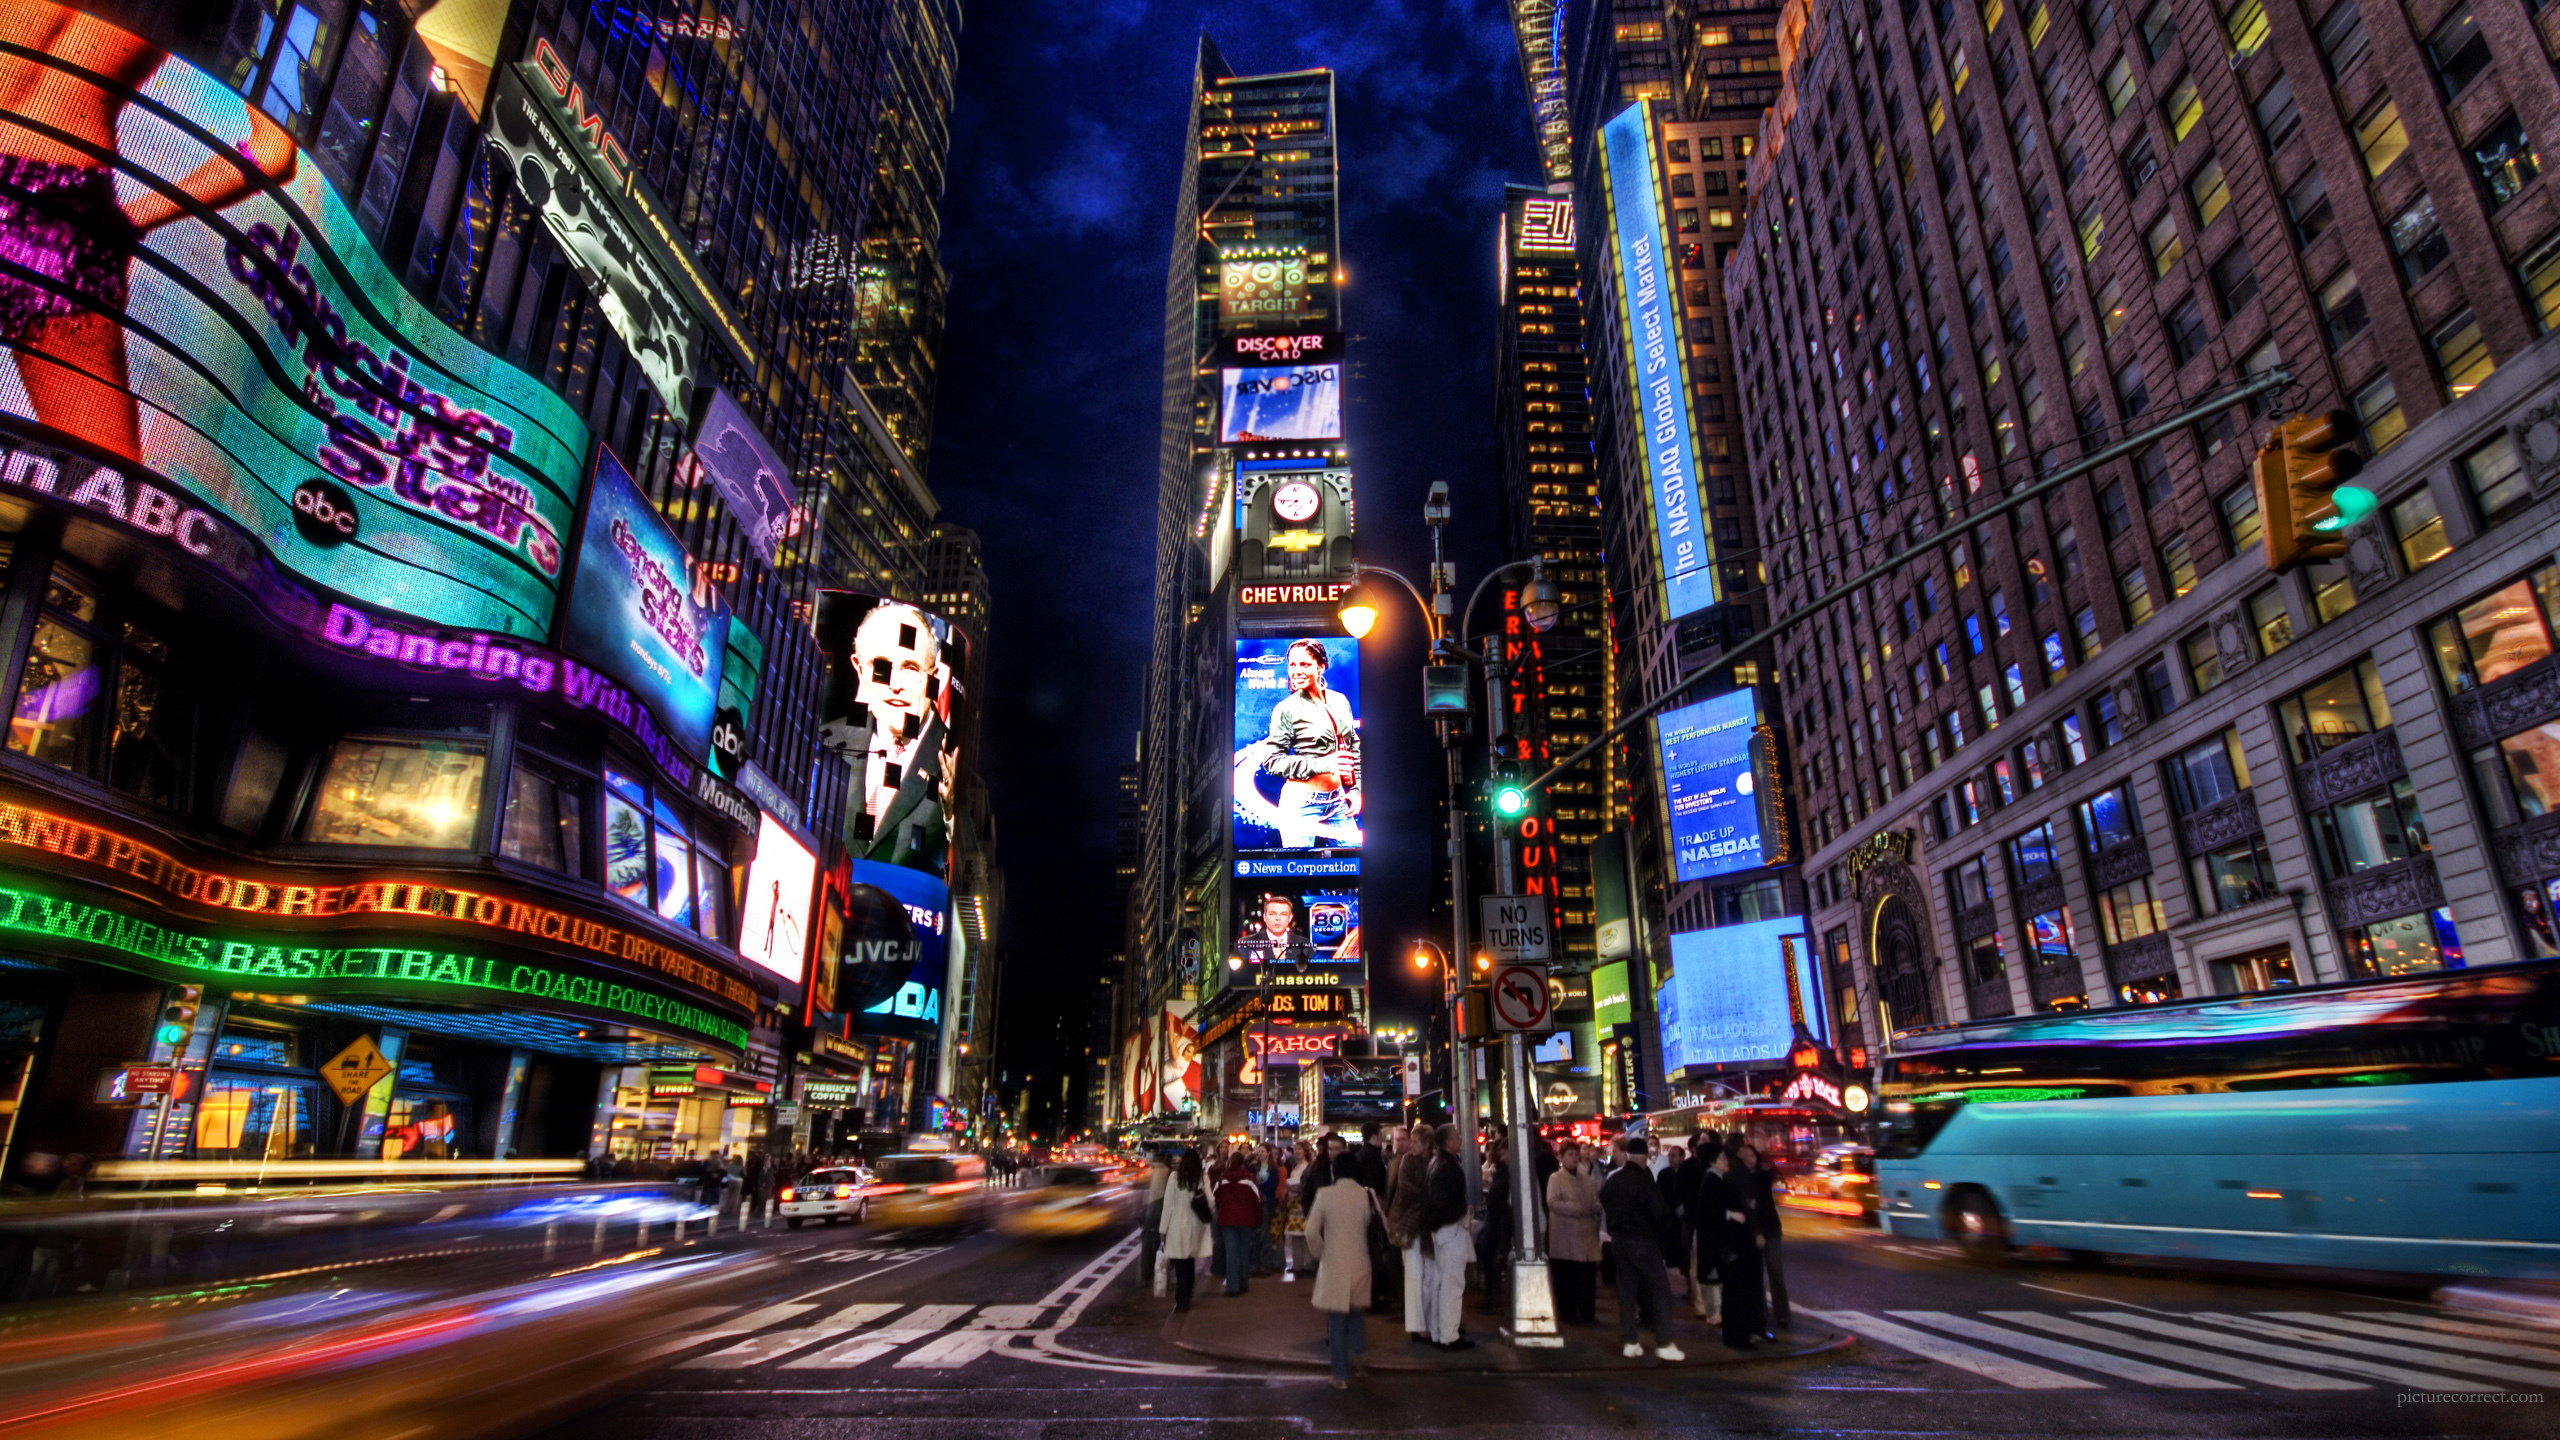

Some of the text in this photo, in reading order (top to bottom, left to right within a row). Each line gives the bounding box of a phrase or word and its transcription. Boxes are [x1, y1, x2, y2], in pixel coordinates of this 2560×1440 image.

[534, 37, 629, 186] GMC
[522, 98, 539, 126] THE
[538, 121, 557, 150] NEW
[556, 146, 576, 175] 2007
[579, 173, 633, 253] YUKON
[633, 187, 755, 365] WE ARE PROFESSIONAL GRADE
[1228, 297, 1300, 314] TARGET
[225, 222, 515, 467] dancing
[1237, 335, 1324, 352] DISCOVER
[1259, 350, 1302, 361] CARD
[1632, 232, 1697, 587] The NASDAQ Global Select Market
[68, 466, 218, 556] ABC
[292, 487, 357, 535] abc
[611, 518, 683, 618] dancing
[1241, 584, 1352, 604] CHEVROLET
[323, 602, 757, 834] Dancing With The Stars Mondays
[1665, 716, 1749, 746] BEST PERFORMING MARKET
[1670, 768, 1695, 780] HIGHEST
[1695, 761, 1718, 774] LISTING
[745, 766, 799, 832] WRIGLEY'S
[1680, 826, 1735, 847] TRADE UP
[1252, 861, 1357, 876] News Corporation
[1314, 914, 1344, 927] 80
[1501, 905, 1528, 924] NO
[281, 882, 436, 917] RECALL
[445, 888, 502, 925] TO
[507, 902, 621, 956] INCLUDE
[622, 933, 659, 967] DRY
[659, 946, 720, 992] VARIETIES
[1488, 927, 1545, 948] TURNS
[845, 940, 899, 964] JVC
[40, 896, 210, 968] WOMEN'S
[219, 940, 503, 989] BASKETBALL
[509, 965, 603, 1006] COACH
[606, 984, 666, 1020] POKEY
[666, 1000, 720, 1038] CHATMAN
[1255, 973, 1339, 986] Pnasonic
[1301, 995, 1329, 1012] TOM
[1691, 1049, 1704, 1063] IT
[1706, 1048, 1726, 1062] ALL
[1733, 1046, 1771, 1060] ADDS
[341, 1071, 369, 1079] SHARE
[341, 1086, 362, 1094] ROAD
[654, 1085, 695, 1094] SEPHORA
[804, 1082, 857, 1094] STARBUCKS
[811, 1093, 847, 1101] COFFEE
[1813, 1077, 1842, 1107] ROCK
[729, 1096, 765, 1104] SEPHORA
